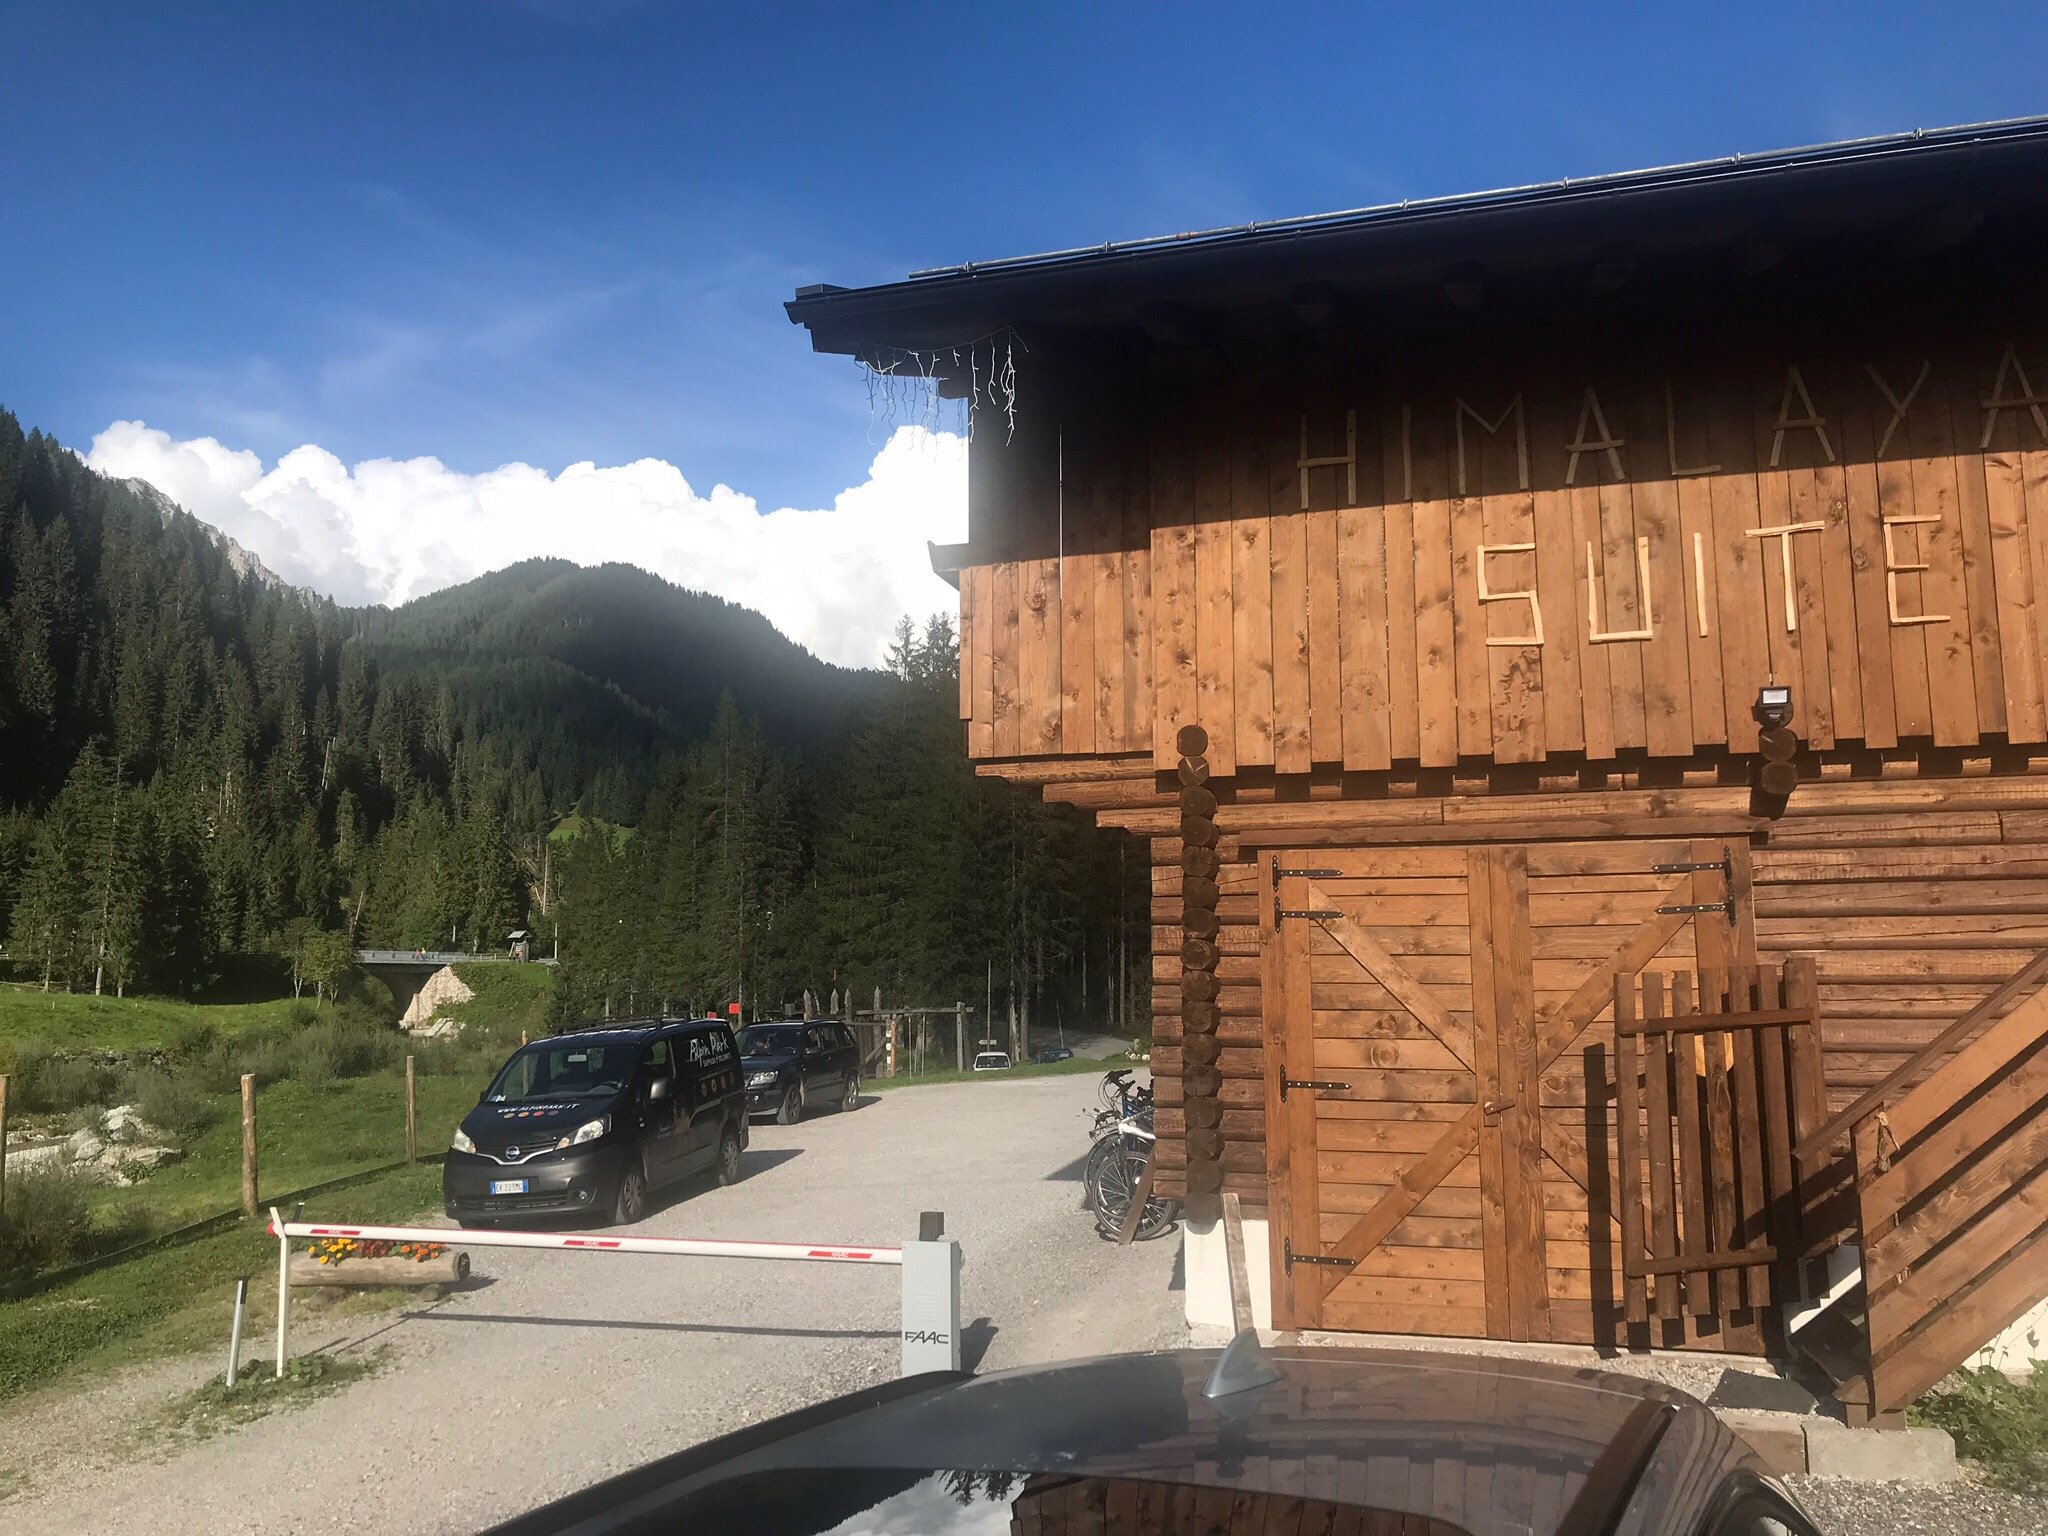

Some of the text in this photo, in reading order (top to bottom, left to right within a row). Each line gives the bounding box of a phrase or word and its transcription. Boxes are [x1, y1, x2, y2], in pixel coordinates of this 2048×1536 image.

[1297, 342, 2048, 510] HIMALAYA
[1477, 513, 1951, 647] SUITE
[689, 1038, 711, 1068] Alpin
[709, 1031, 729, 1055] Park
[904, 1330, 949, 1345] FAAC
